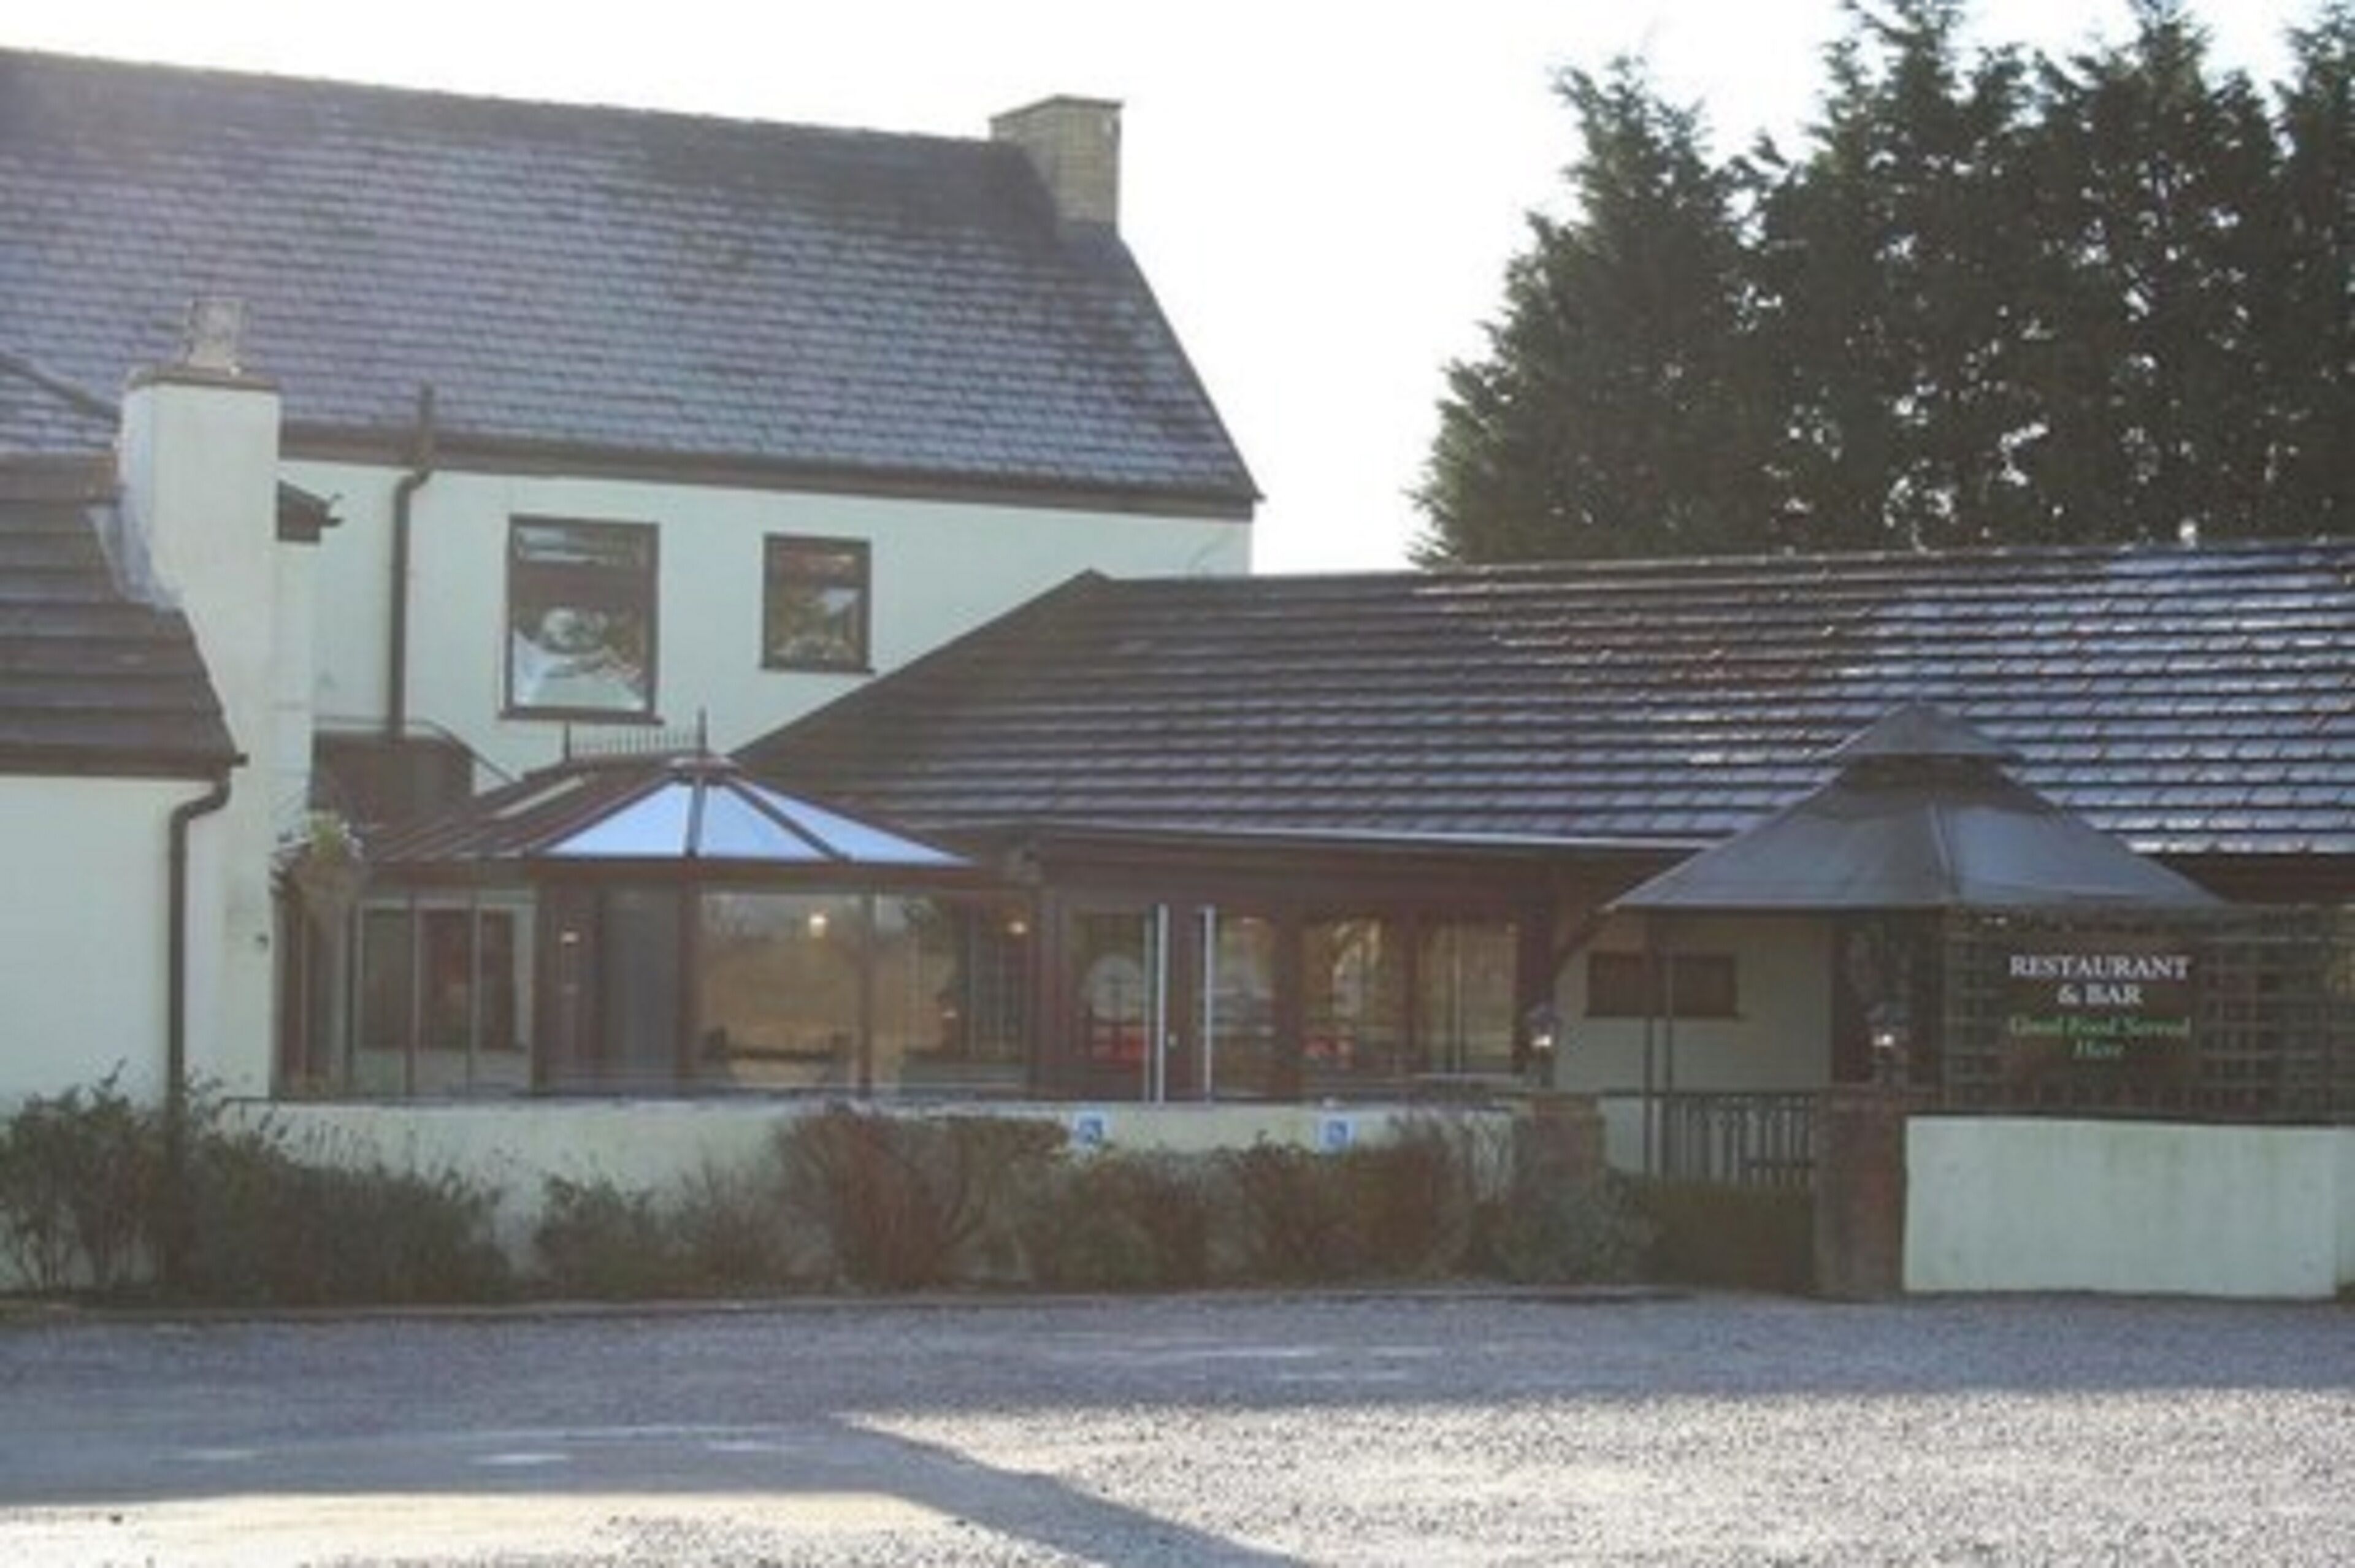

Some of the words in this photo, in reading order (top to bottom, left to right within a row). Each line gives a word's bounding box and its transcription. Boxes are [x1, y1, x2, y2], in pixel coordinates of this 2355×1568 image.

[2009, 955, 2191, 979] RESTAURANT
[2058, 984, 2079, 1004] &
[2085, 984, 2143, 1005] BAR
